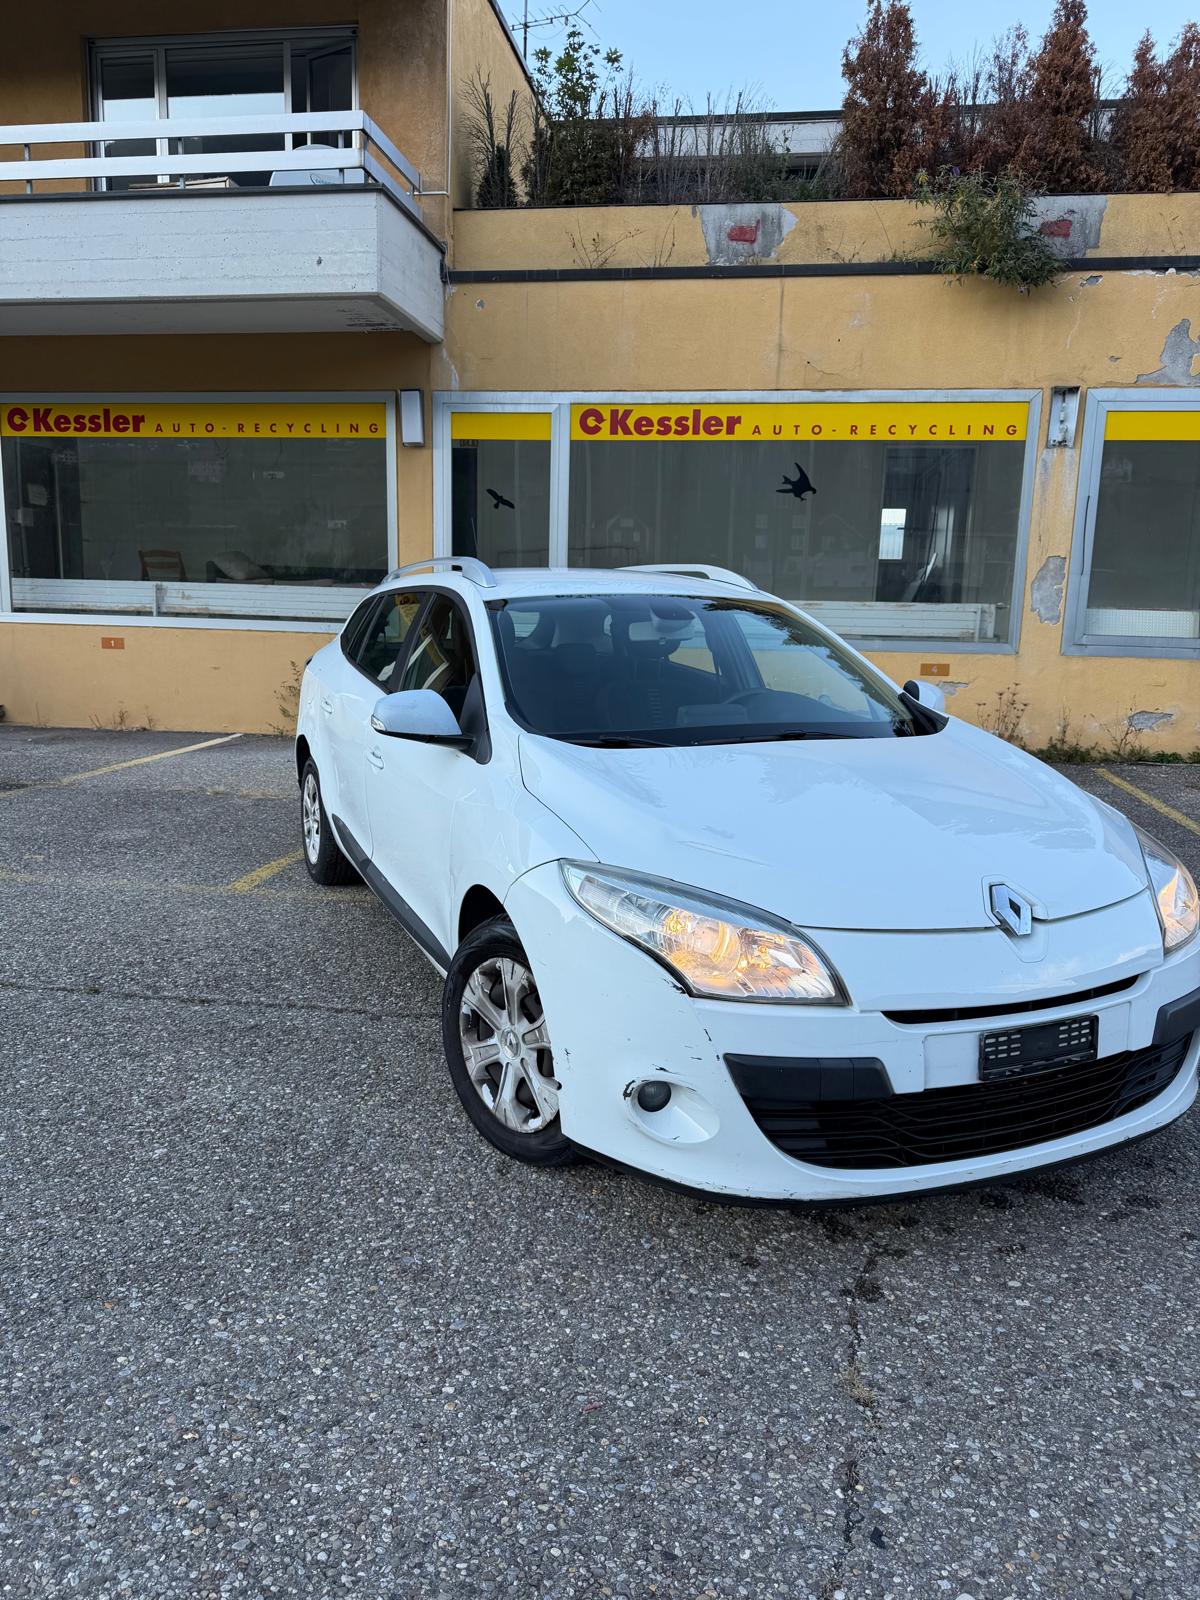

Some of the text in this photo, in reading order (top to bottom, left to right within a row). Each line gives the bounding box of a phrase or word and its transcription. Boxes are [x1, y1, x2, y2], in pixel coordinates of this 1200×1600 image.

[32, 408, 379, 433] Kessler AUTO-RECYCLING
[609, 408, 1018, 437] Kessler AUTO-RECYCLING
